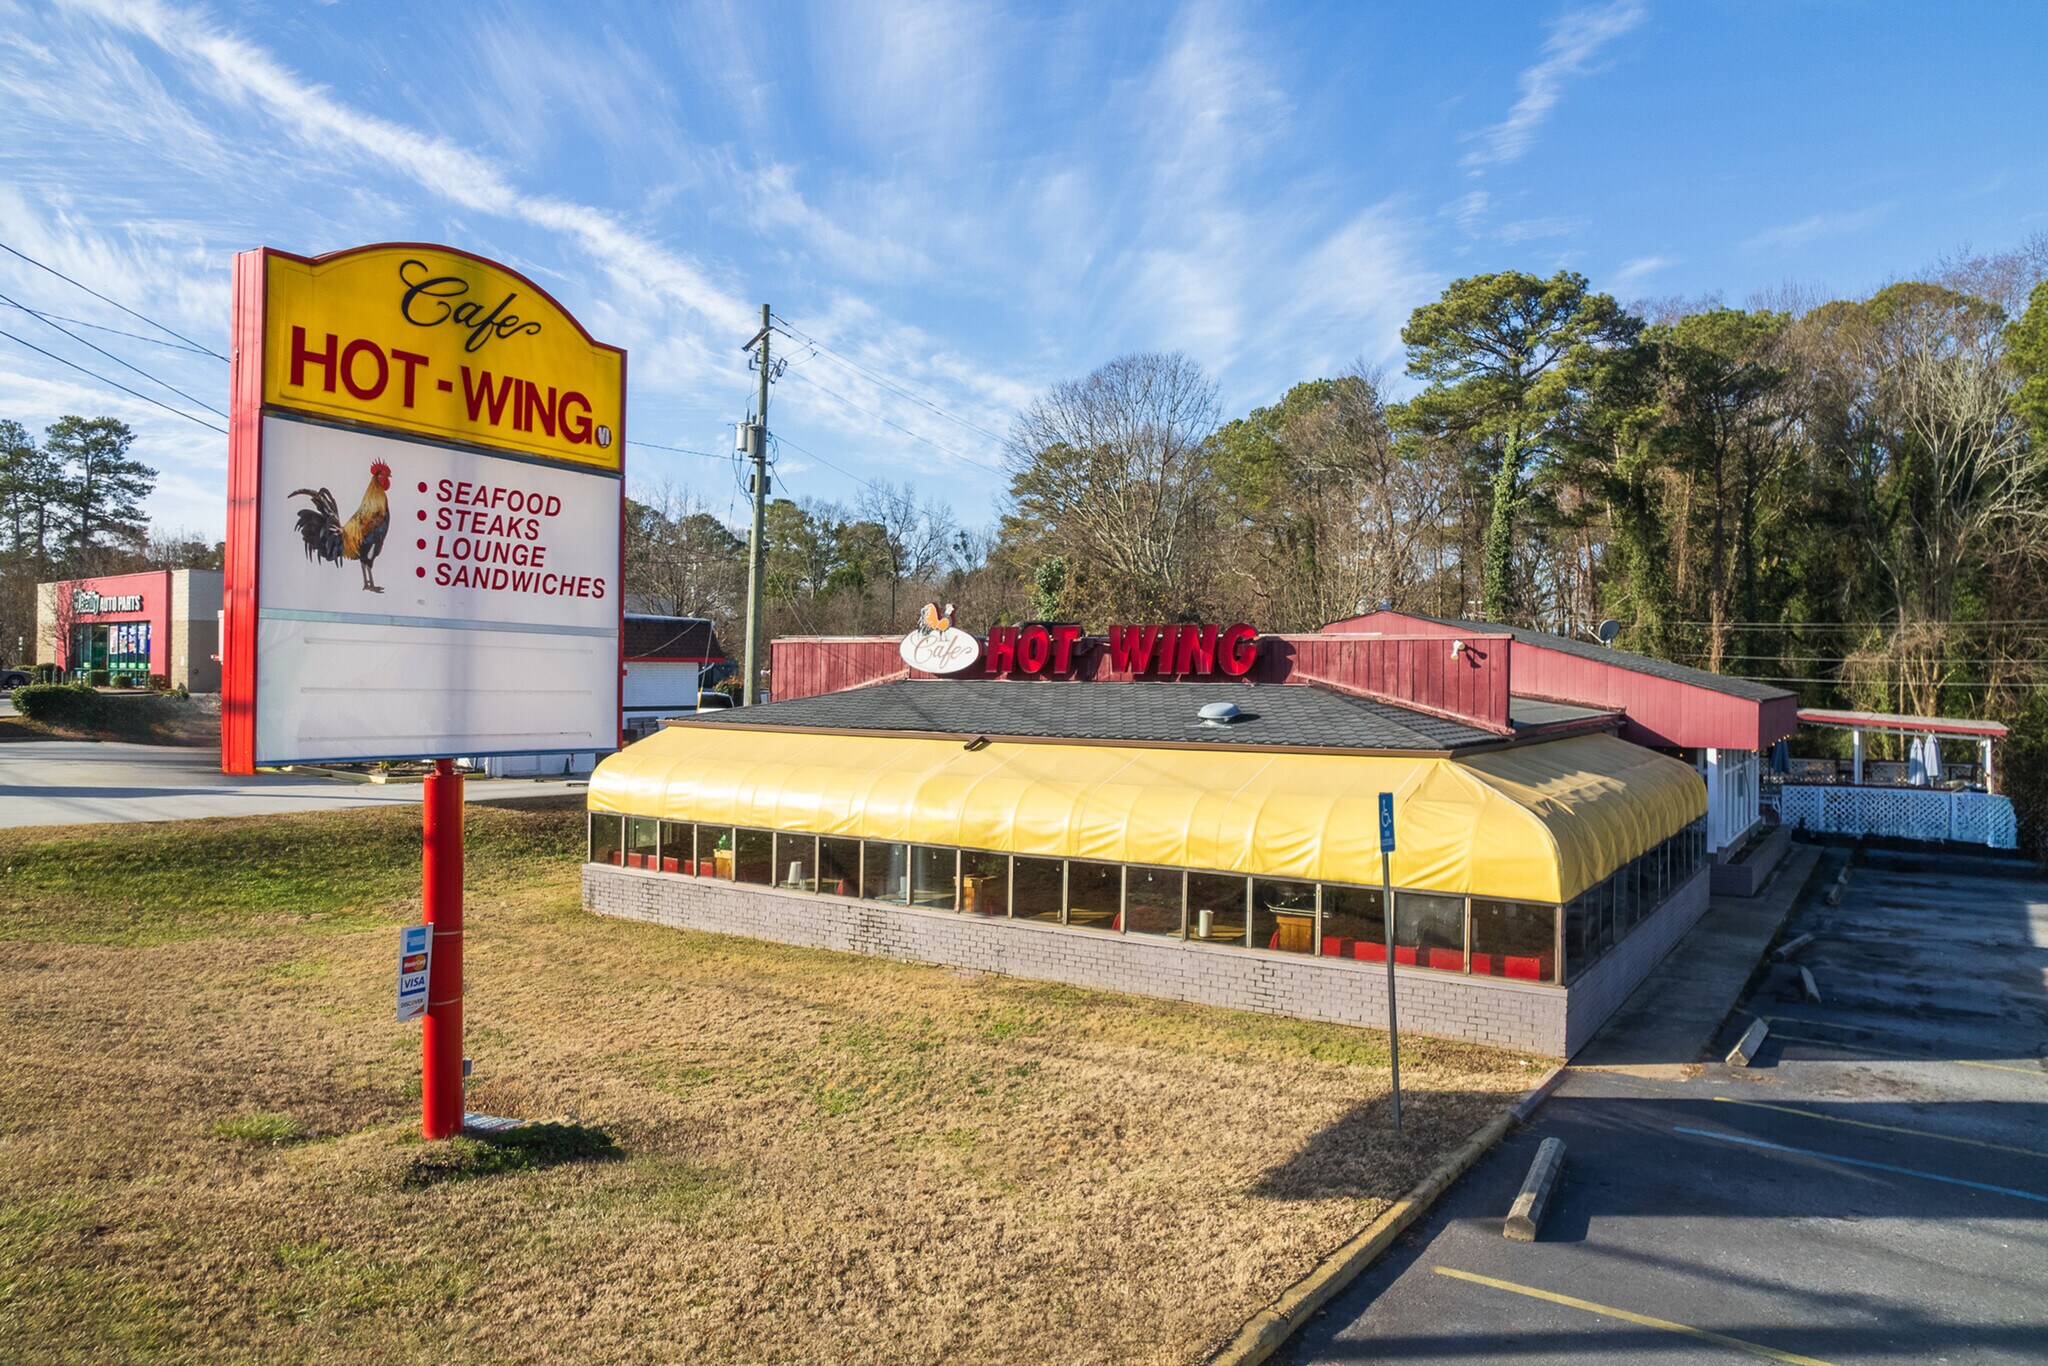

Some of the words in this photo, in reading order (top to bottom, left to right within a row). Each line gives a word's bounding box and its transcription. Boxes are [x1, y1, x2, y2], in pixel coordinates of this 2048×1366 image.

[399, 259, 541, 353] Cafe
[436, 479, 562, 517] SEAFOOD
[435, 507, 540, 541] STEAKS
[435, 535, 547, 568] LOUNGE
[434, 563, 606, 599] SANDWICHES
[100, 597, 117, 612] AUTO
[118, 595, 141, 611] PARTS
[913, 634, 972, 669] Cafe
[985, 625, 1082, 674] HOT
[1108, 622, 1261, 676] WING
[404, 976, 425, 989] VISA
